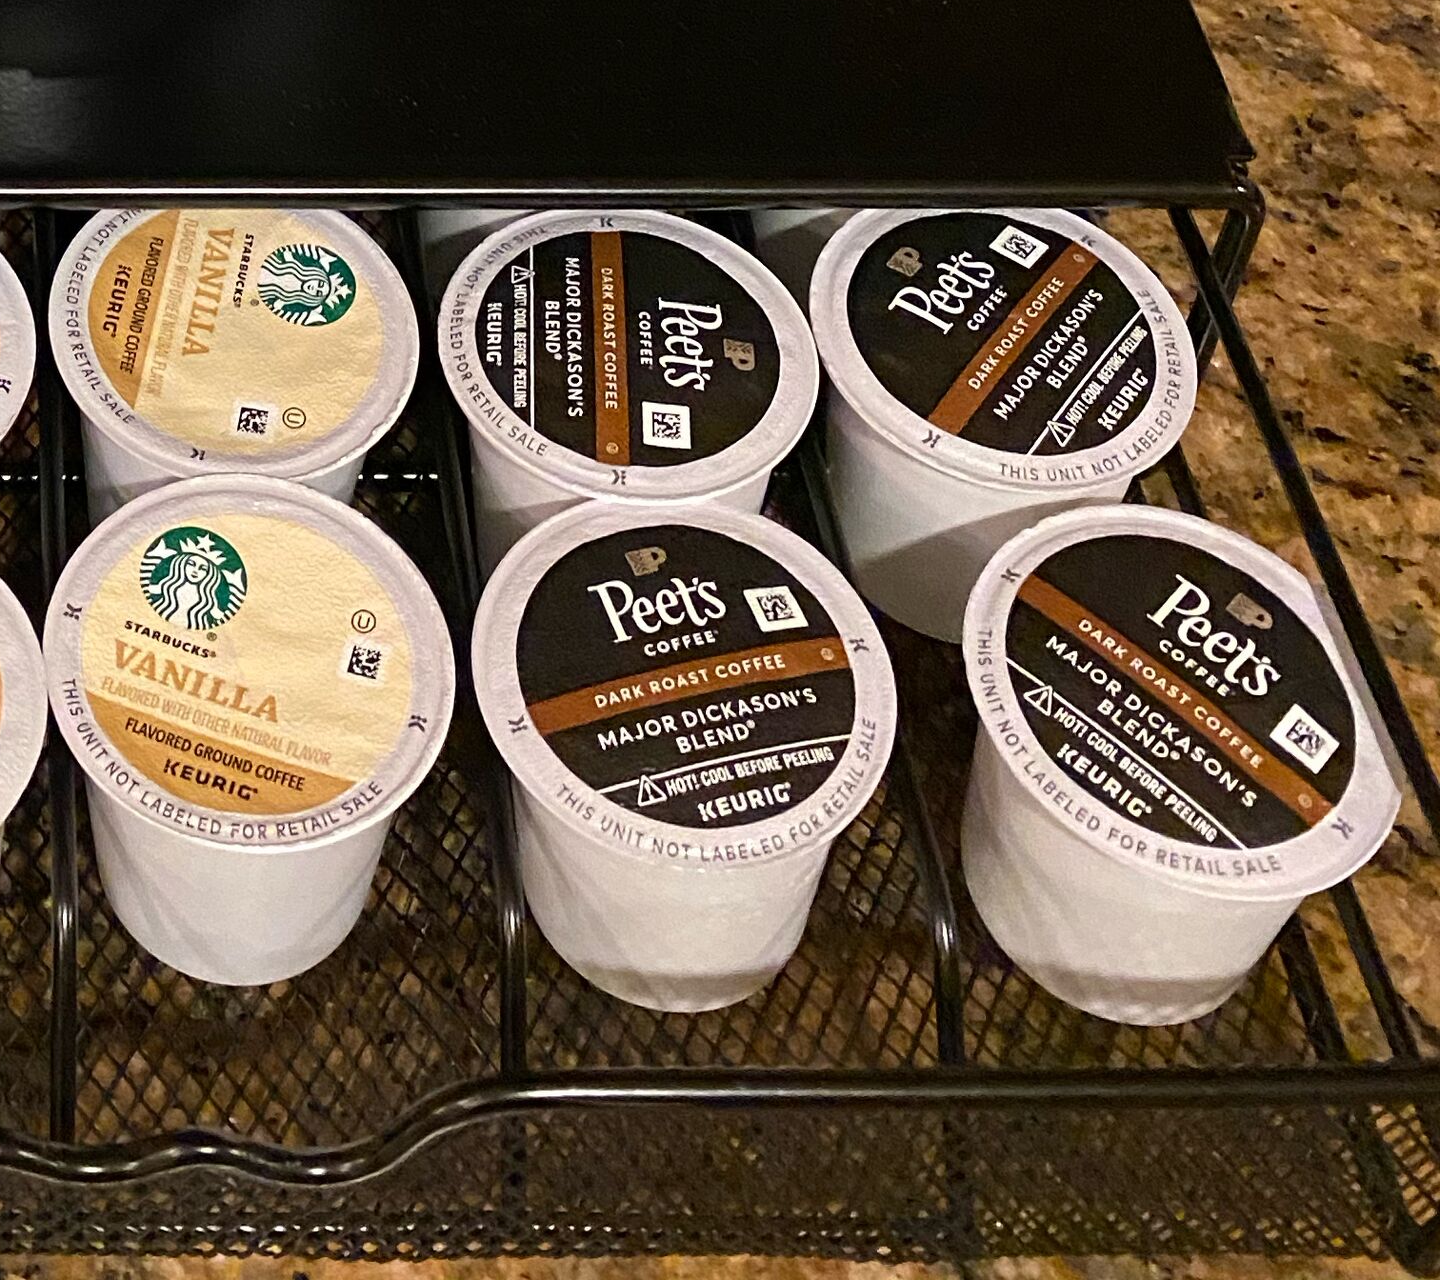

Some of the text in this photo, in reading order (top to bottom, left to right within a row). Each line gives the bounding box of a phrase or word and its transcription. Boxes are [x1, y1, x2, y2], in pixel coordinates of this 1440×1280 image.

[66, 220, 135, 424] NOT LABELED FOR RETAIL SALE
[120, 237, 164, 375] FLAVORED GROUND COFFEE
[182, 227, 235, 356] VANILLA
[566, 256, 583, 418] MAJOR DICKASON'S
[601, 268, 618, 410] DARK ROAST COFFEE
[638, 311, 653, 366] COFFEE
[658, 297, 722, 392] Peet's
[888, 251, 995, 335] Peet's
[967, 288, 1007, 332] COFFEE
[967, 276, 1065, 391] DARK ROAST COFFEE
[992, 288, 1104, 420] MAJOR DICKASON'S
[1000, 288, 1182, 482] THIS UNIT NOT LABELED FOR RETAIL SALE
[1065, 325, 1148, 427] HOT! COOL BEFORE PEELING
[587, 577, 726, 644] Peet's
[644, 630, 717, 658] COFFEE
[1146, 573, 1282, 697] Peet's
[1158, 638, 1229, 698] COFFEE
[114, 638, 279, 724] VANILLA
[594, 654, 786, 709] DARK ROAST COFFEE
[598, 688, 818, 752] MAJOR DICKASON'S
[1044, 635, 1259, 809] MAJOR DICKASON'S
[1078, 618, 1264, 769] DARK ROAST COFFEE
[62, 678, 383, 840] THIS UNIT NOT LABELED FOR RETAIL SALE
[126, 717, 306, 791] FLAVORED GROUND COFFEE
[557, 718, 878, 863] THIS UNIT NOT LABELED FOR RETAIL SALE
[664, 746, 834, 797] HOT! COOL BEFORE PEELING
[977, 629, 1283, 878] THIS UNIT NOT LABELED FOR RETAIL SALE
[1052, 707, 1219, 844] HOT! COOL BEFORE PEELING
